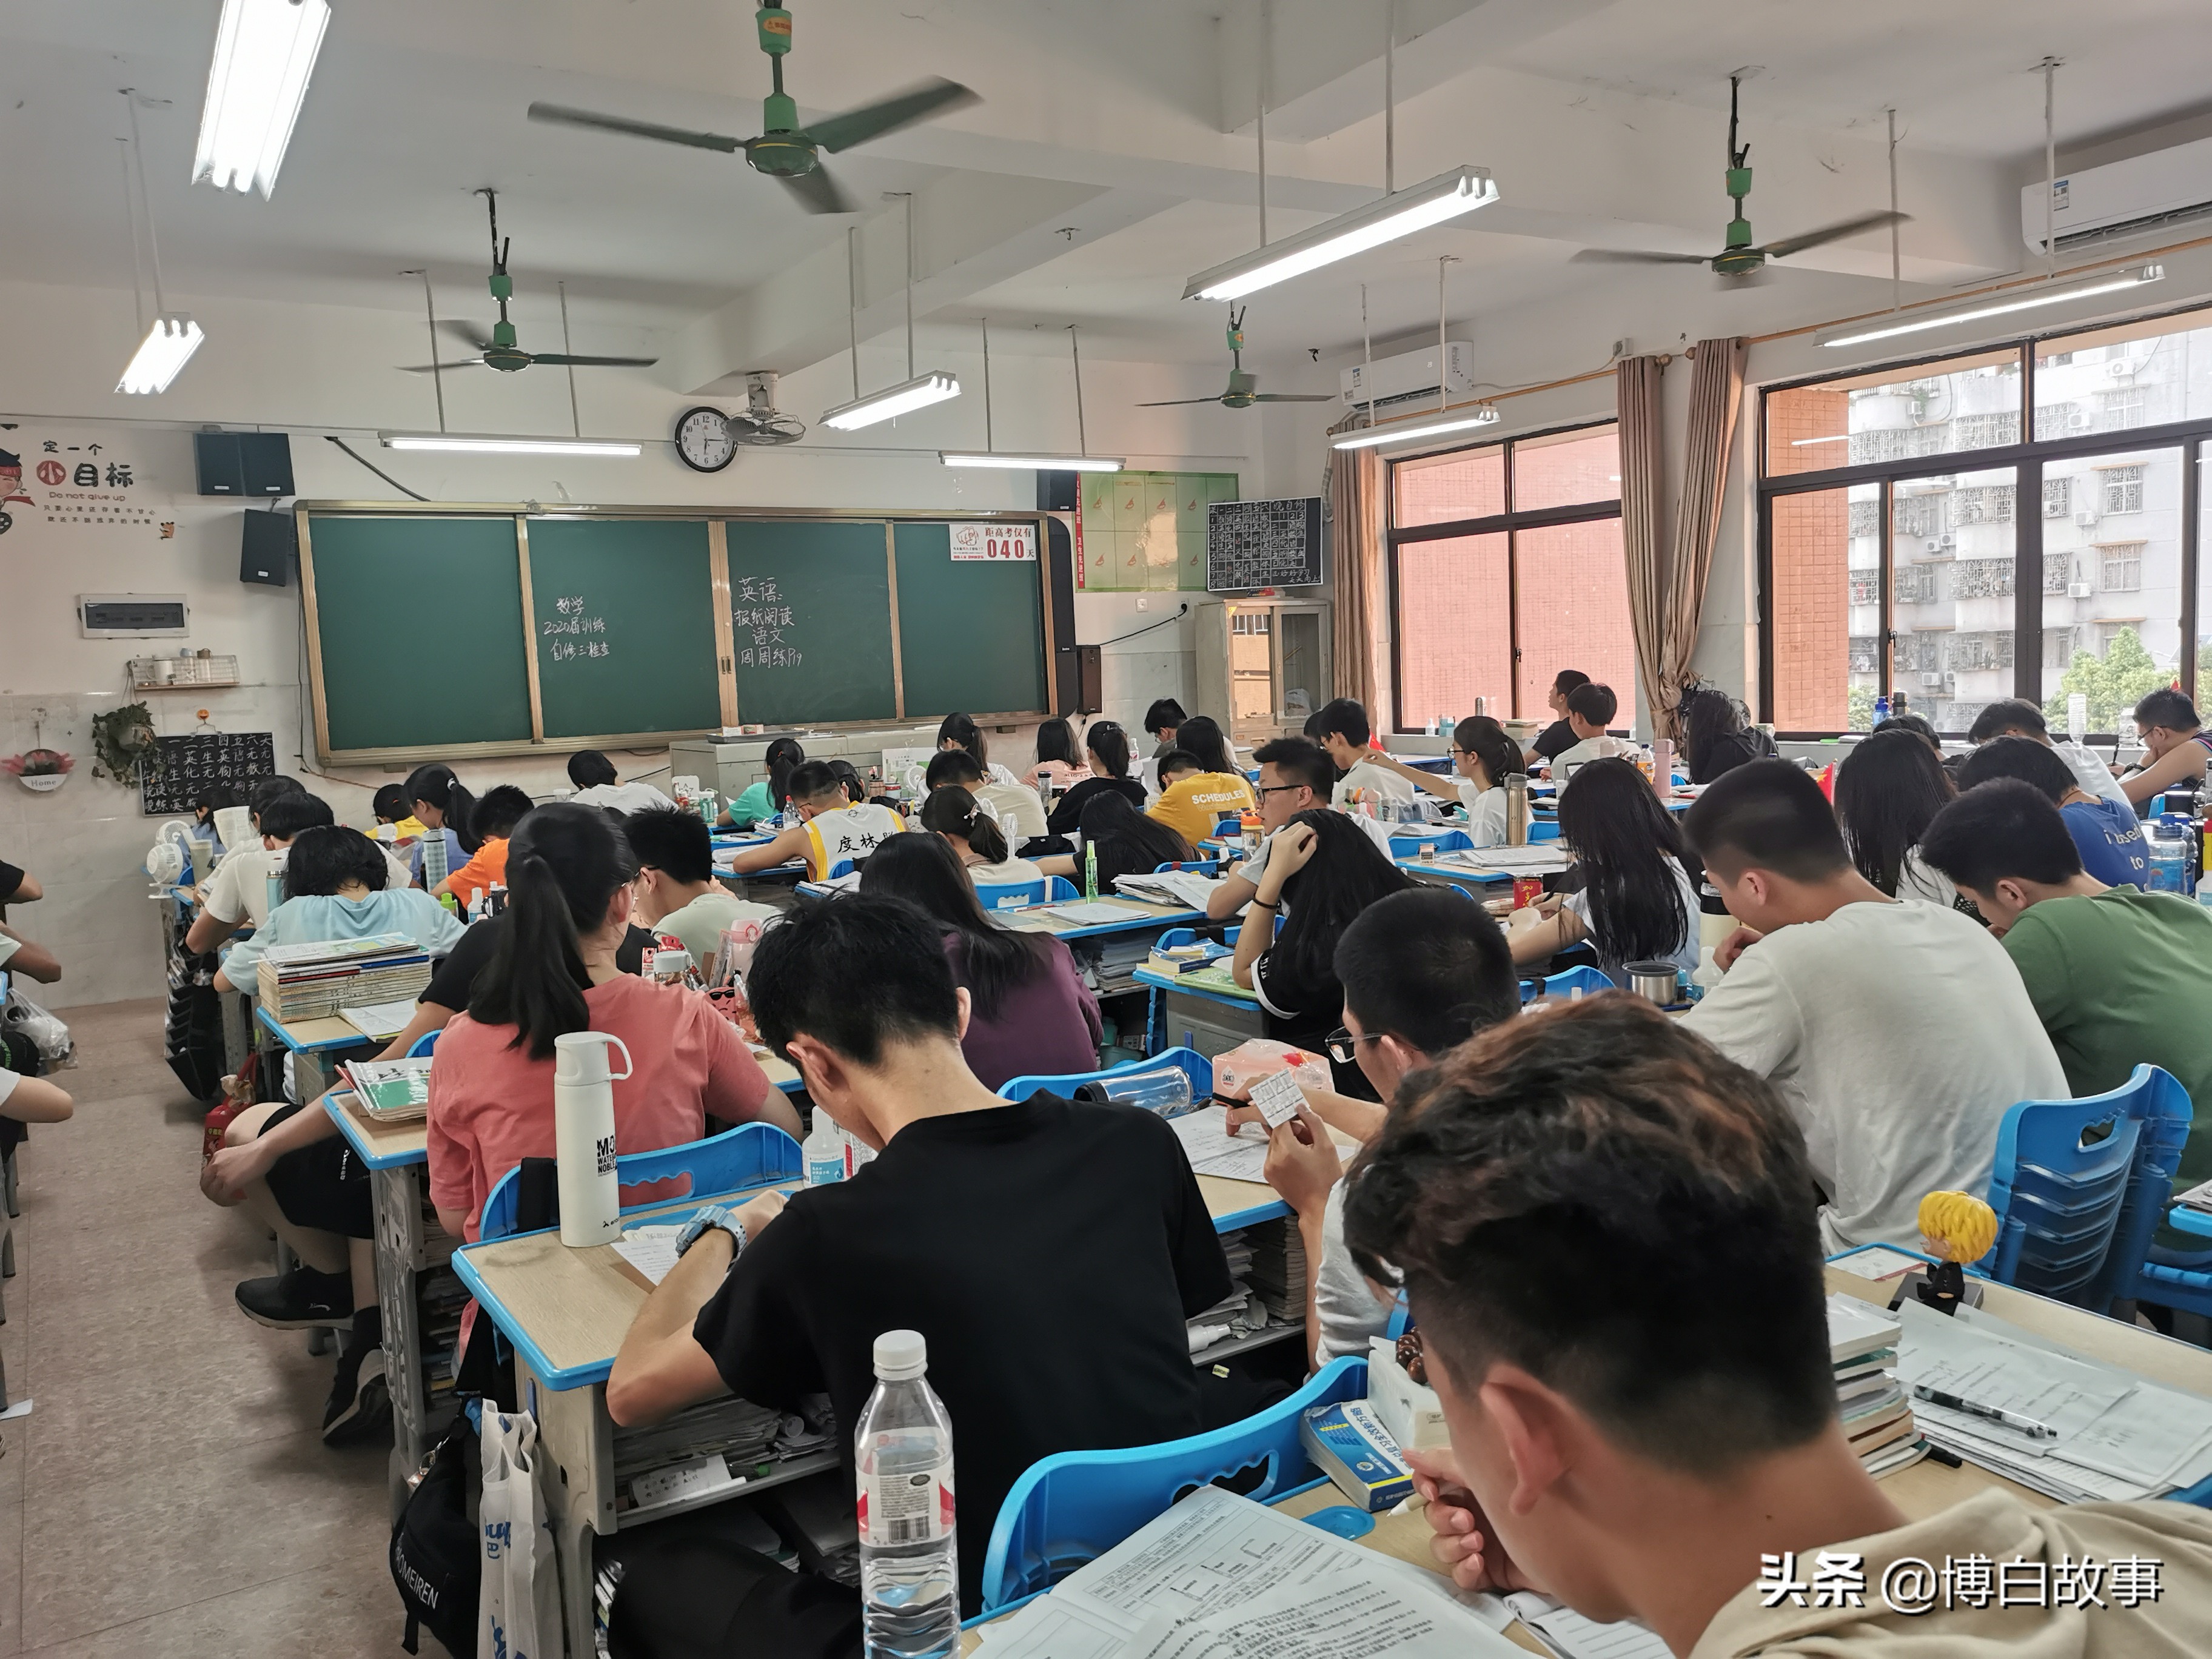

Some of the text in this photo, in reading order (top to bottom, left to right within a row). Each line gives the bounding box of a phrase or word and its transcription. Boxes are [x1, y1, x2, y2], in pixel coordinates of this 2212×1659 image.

[43, 440, 102, 456] 定一个
[37, 460, 133, 487] 小目标
[985, 527, 1032, 538] 距高考仅有
[987, 538, 1025, 559] 040
[1026, 548, 1034, 558] 天
[556, 595, 585, 615] 数学
[734, 605, 796, 627] 报纸阅读
[752, 627, 786, 645] 语文
[1191, 789, 1245, 805] SCHEDULES
[2113, 822, 2142, 845] used
[2130, 856, 2144, 870] to
